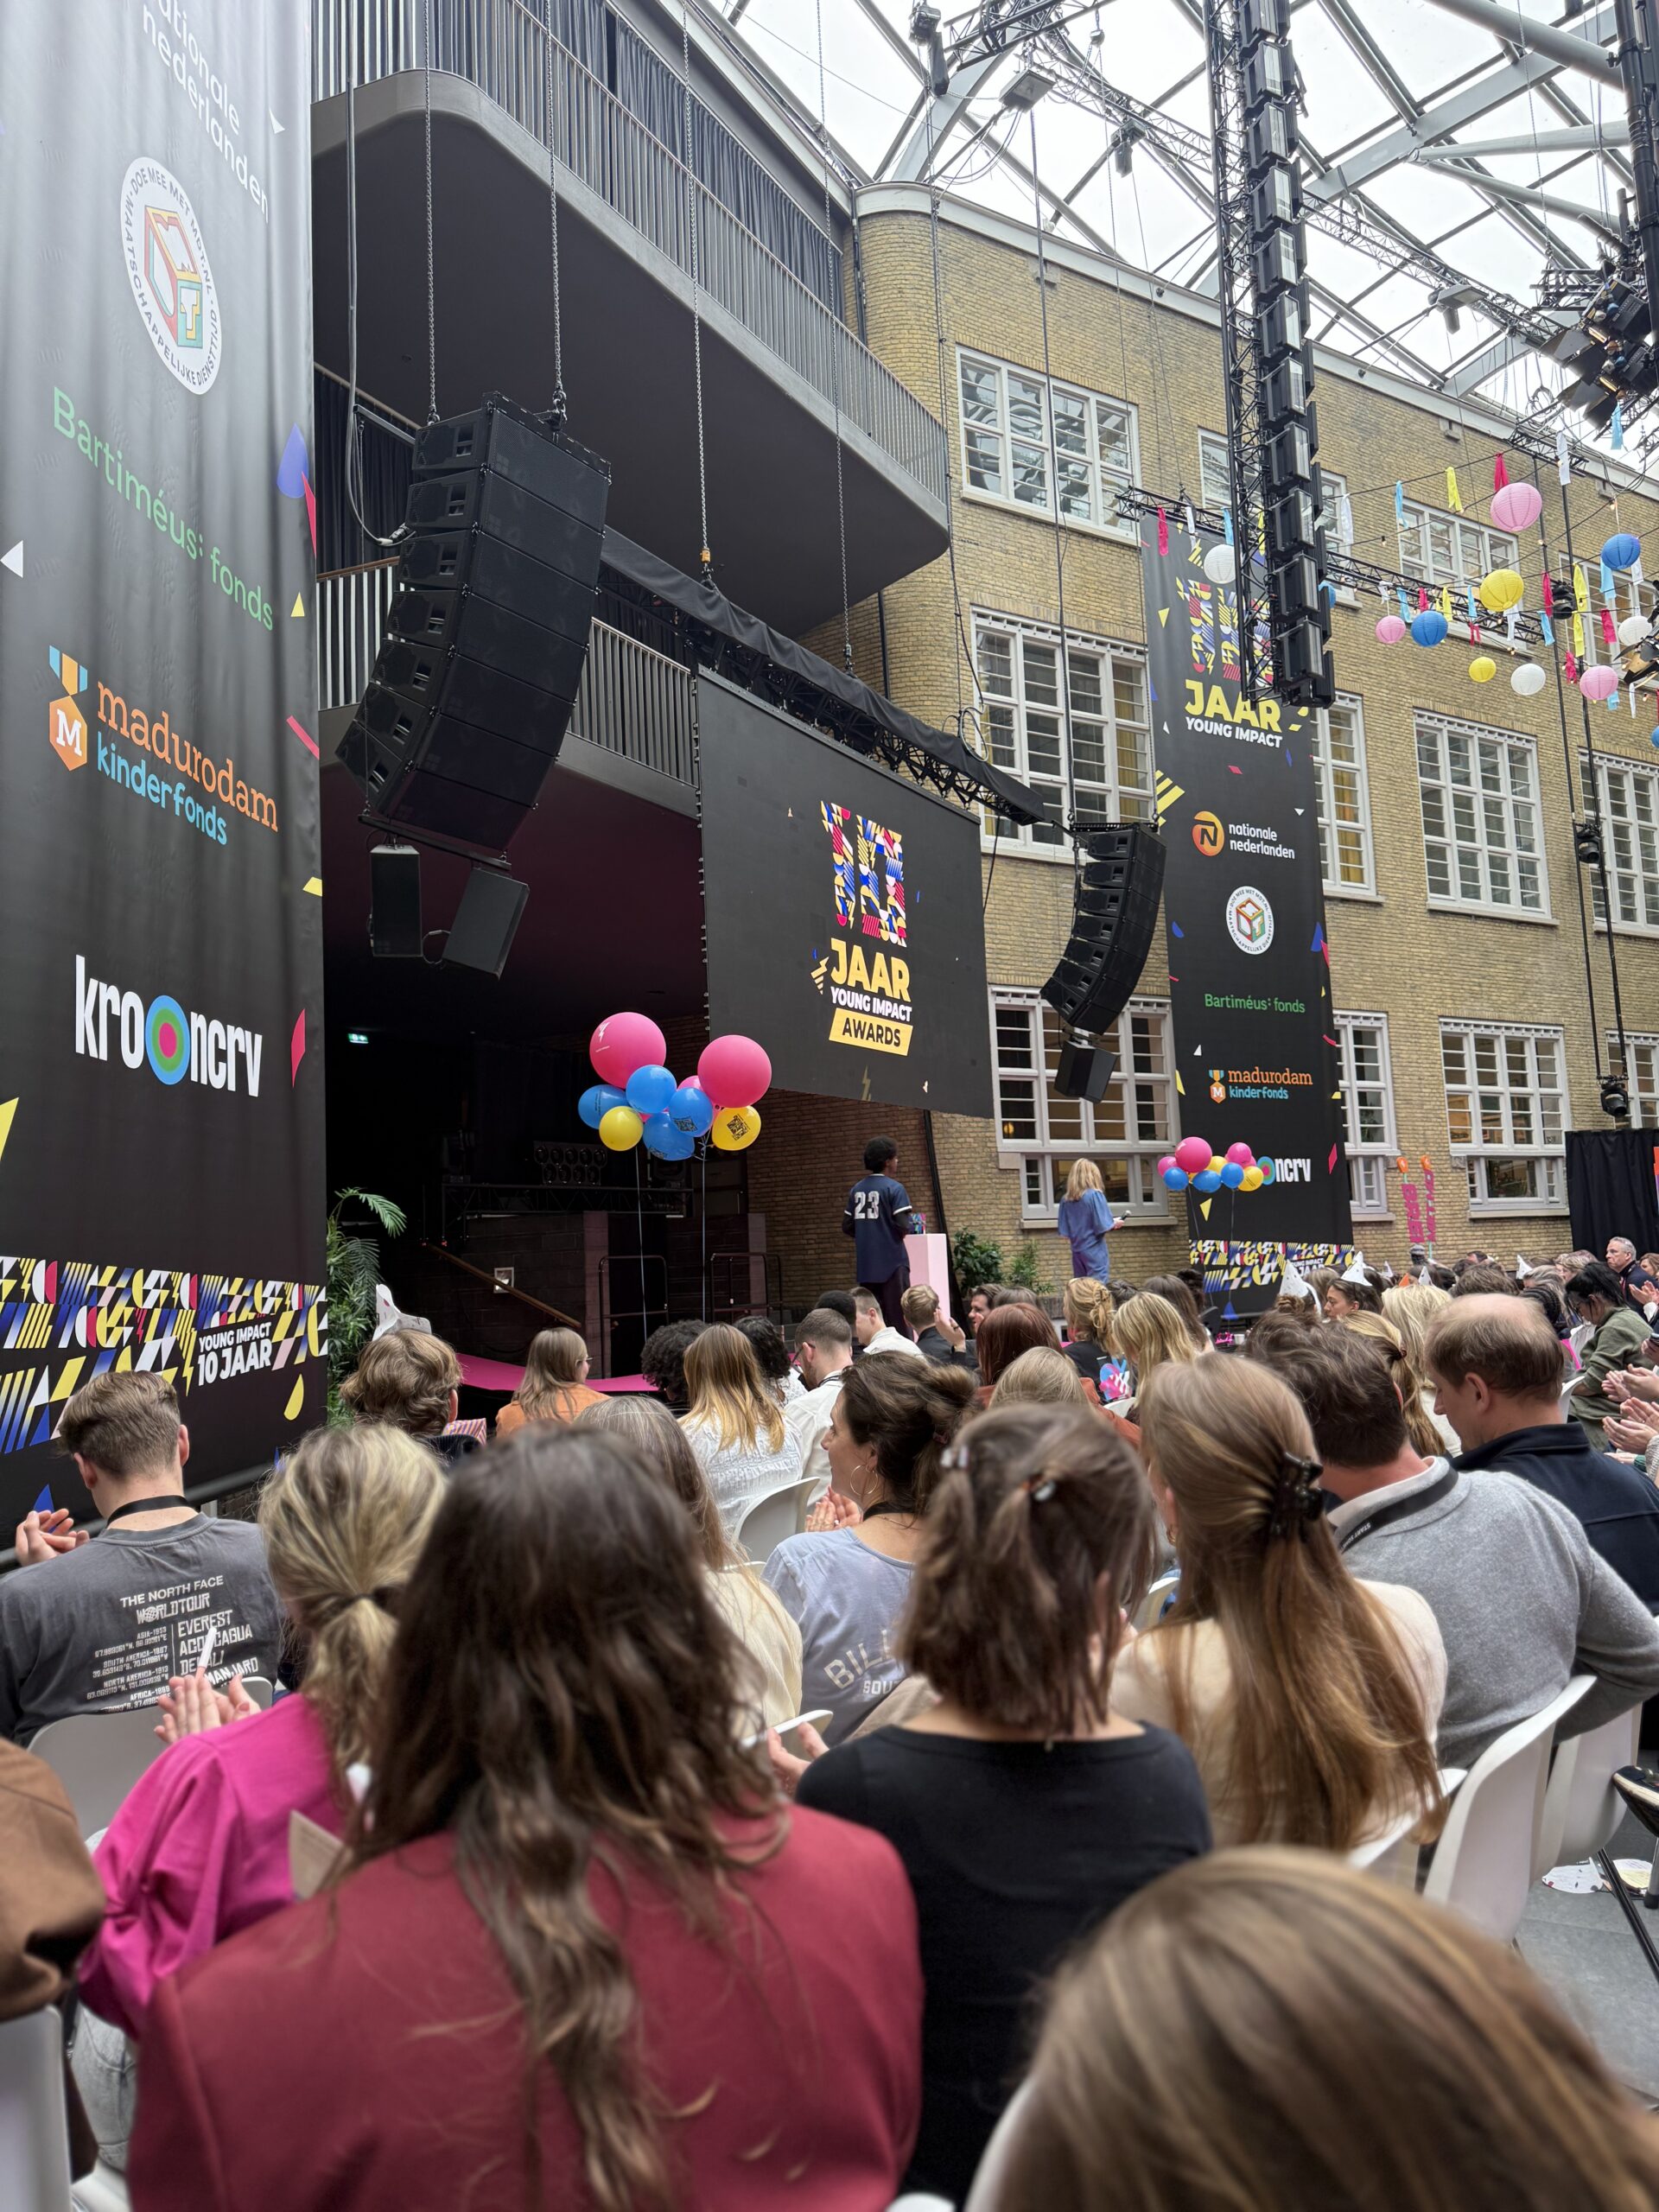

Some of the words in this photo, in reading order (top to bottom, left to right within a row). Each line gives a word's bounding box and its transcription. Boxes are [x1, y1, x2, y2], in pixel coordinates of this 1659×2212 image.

[158, 0, 239, 136] ationale
[143, 3, 269, 224] nederlanden
[130, 168, 148, 195] DOE
[148, 167, 168, 190] MEE
[169, 181, 190, 216] MET
[124, 194, 196, 385] MAATSCHAPPELIJKE
[210, 546, 274, 632] fonds
[1185, 679, 1283, 734] JAAR
[1185, 716, 1232, 739] YOUNG
[1235, 726, 1283, 748] IMPACT
[97, 681, 279, 832] madurodam
[97, 731, 228, 846] kinderfonds
[1229, 823, 1278, 842] nationale
[1230, 838, 1295, 860] nederlanden
[830, 937, 912, 1003] JAAR
[830, 986, 871, 1013] YOUNG
[873, 996, 912, 1023] IMPACT
[1274, 997, 1306, 1014] fonds
[842, 1016, 901, 1047] AWARDS
[1228, 1065, 1313, 1085] madurodam
[1229, 1085, 1288, 1100] kinderfonds
[854, 1190, 880, 1220] 23
[199, 1330, 234, 1353] YOUNG
[236, 1321, 271, 1344] IMPACT
[197, 1351, 219, 1387] 10
[219, 1338, 272, 1380] JAAR
[120, 1593, 145, 1608] THE
[148, 1582, 191, 1603] NORTH
[194, 1574, 224, 1591] FACE
[177, 1609, 233, 1637] EVEREST
[179, 1624, 253, 1657] ACOCAGUA
[103, 1656, 124, 1669] SOUTH
[179, 1649, 225, 1676] DEALI
[104, 1676, 124, 1688] NORTH
[862, 1680, 900, 1695] SOU
